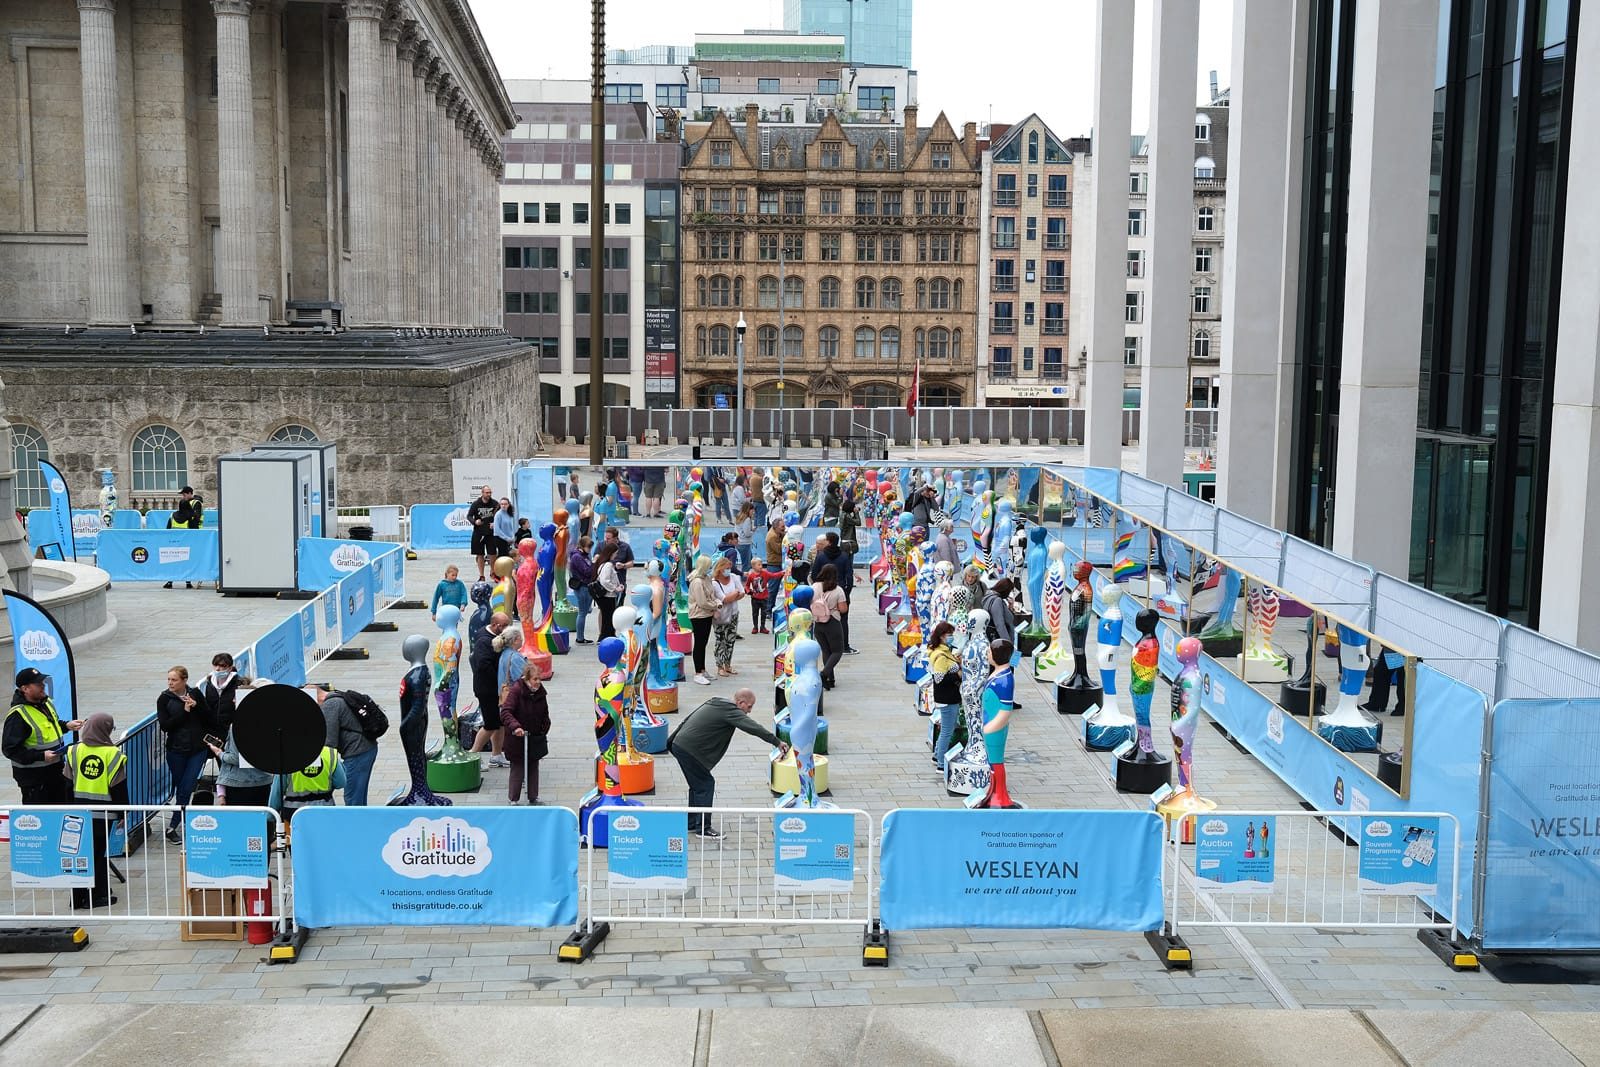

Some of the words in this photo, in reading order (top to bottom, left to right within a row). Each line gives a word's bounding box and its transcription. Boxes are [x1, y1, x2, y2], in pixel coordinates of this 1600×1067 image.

[190, 835, 222, 844] Tickets
[612, 835, 644, 844] Tickets
[1029, 832, 1055, 840] sponsor
[1018, 841, 1057, 849] Birmingham
[1200, 839, 1233, 847] Auction
[1364, 847, 1402, 855] Programme
[1529, 849, 1546, 858] we
[1548, 848, 1570, 857] are
[1574, 846, 1590, 856] all
[402, 851, 476, 865] Gratitude
[965, 860, 1079, 879] WESLEYAN
[387, 889, 424, 897] locations,
[457, 887, 493, 896] Gratitude
[1005, 886, 1019, 895] all
[1022, 886, 1054, 895] about
[1055, 887, 1077, 897] you
[392, 902, 483, 912] thisisgratitude.co.uk
